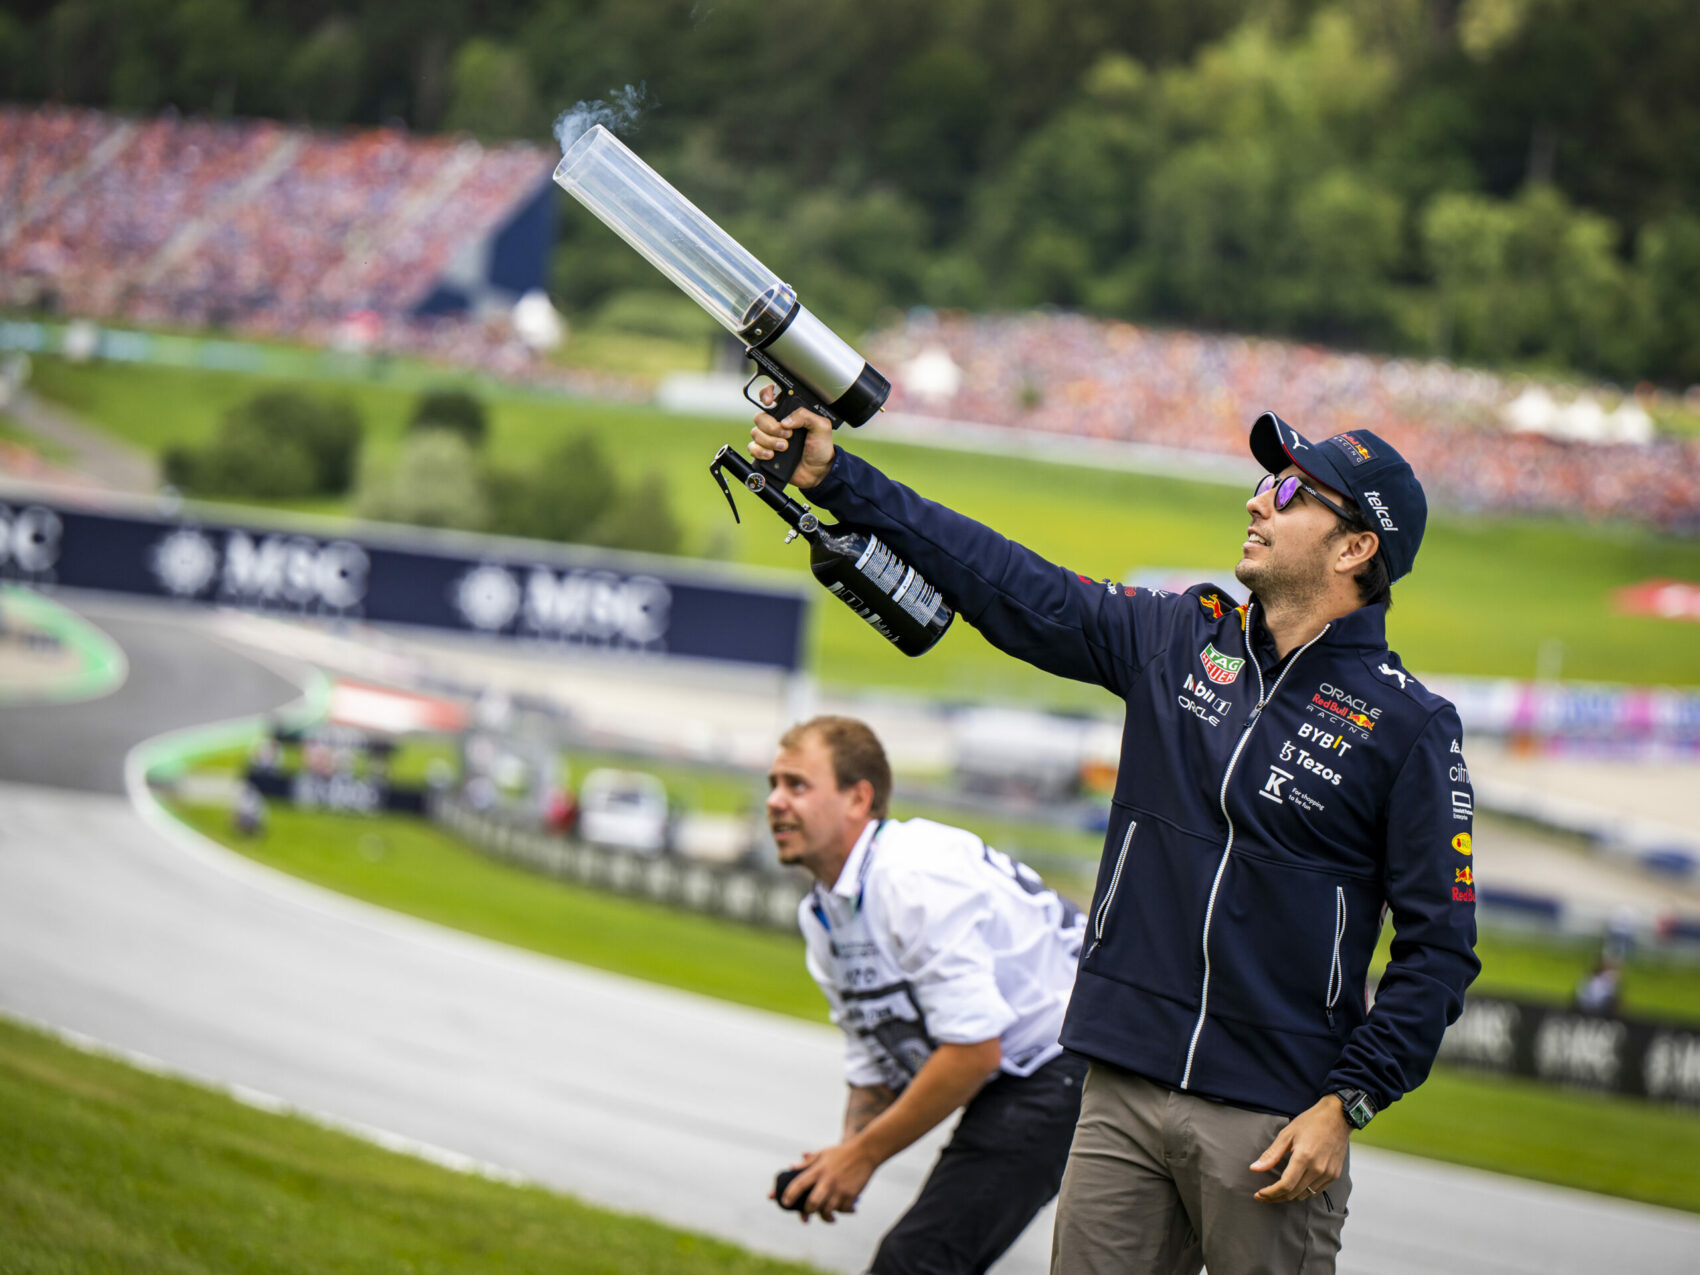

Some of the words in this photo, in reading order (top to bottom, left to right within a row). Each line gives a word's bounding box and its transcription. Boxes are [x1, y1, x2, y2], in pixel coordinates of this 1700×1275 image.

[1364, 491, 1399, 531] telcel
[1202, 653, 1236, 682] HEUER
[1209, 647, 1240, 671] TAG
[1183, 673, 1216, 703] Mbil
[1320, 682, 1383, 720] ORACLE
[1306, 704, 1370, 740] RACING
[1297, 722, 1352, 757] BYBIT
[1296, 749, 1342, 786] Tezos
[1264, 772, 1288, 797] K
[1291, 787, 1301, 796] For
